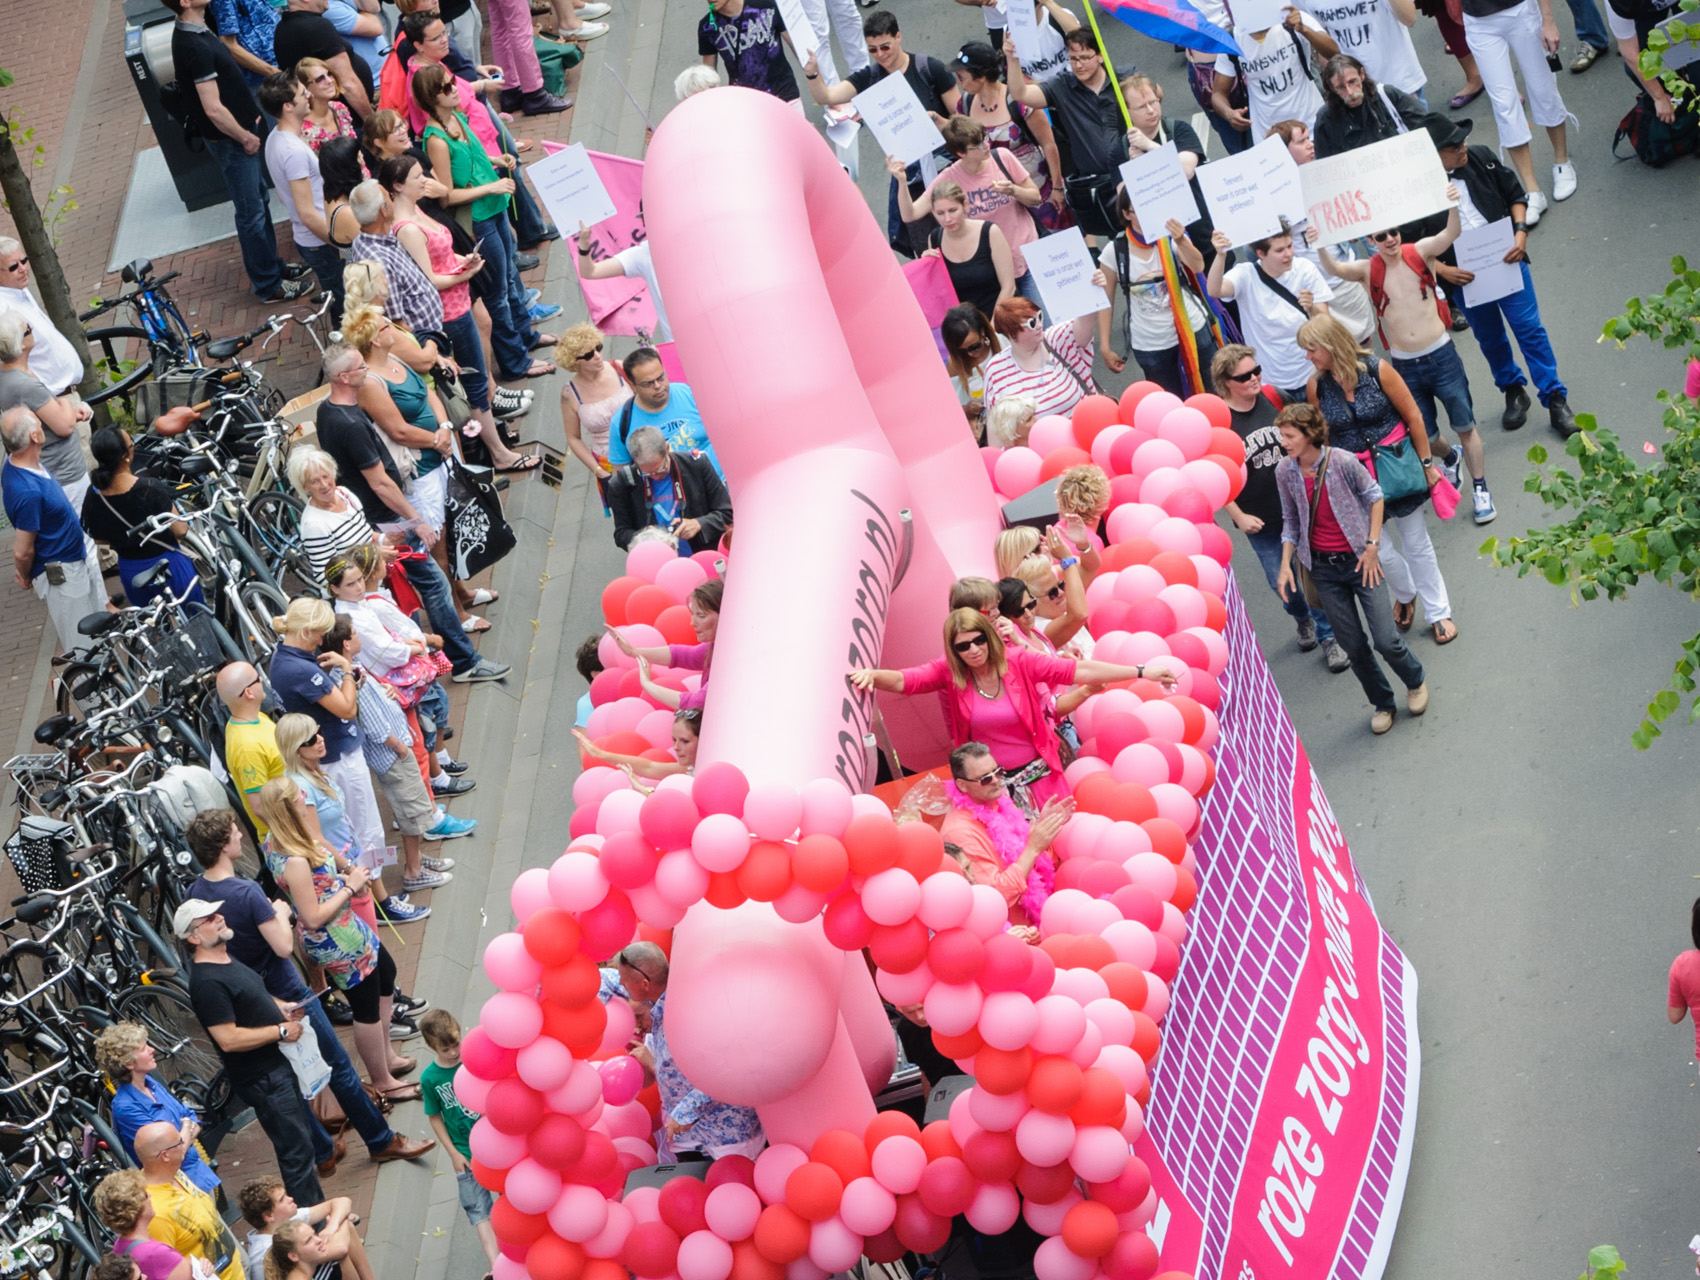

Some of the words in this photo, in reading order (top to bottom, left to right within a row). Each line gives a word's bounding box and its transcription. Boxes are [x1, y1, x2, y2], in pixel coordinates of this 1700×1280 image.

[1335, 24, 1371, 48] NU!
[132, 61, 147, 80] REST
[1020, 47, 1069, 77] RANSWE
[1241, 43, 1297, 73] RANSWET
[1259, 68, 1293, 96] NU!
[1252, 445, 1284, 469] USA
[1313, 866, 1359, 1000] onze
[1294, 976, 1370, 1136] zorg
[1257, 1116, 1325, 1268] roze
